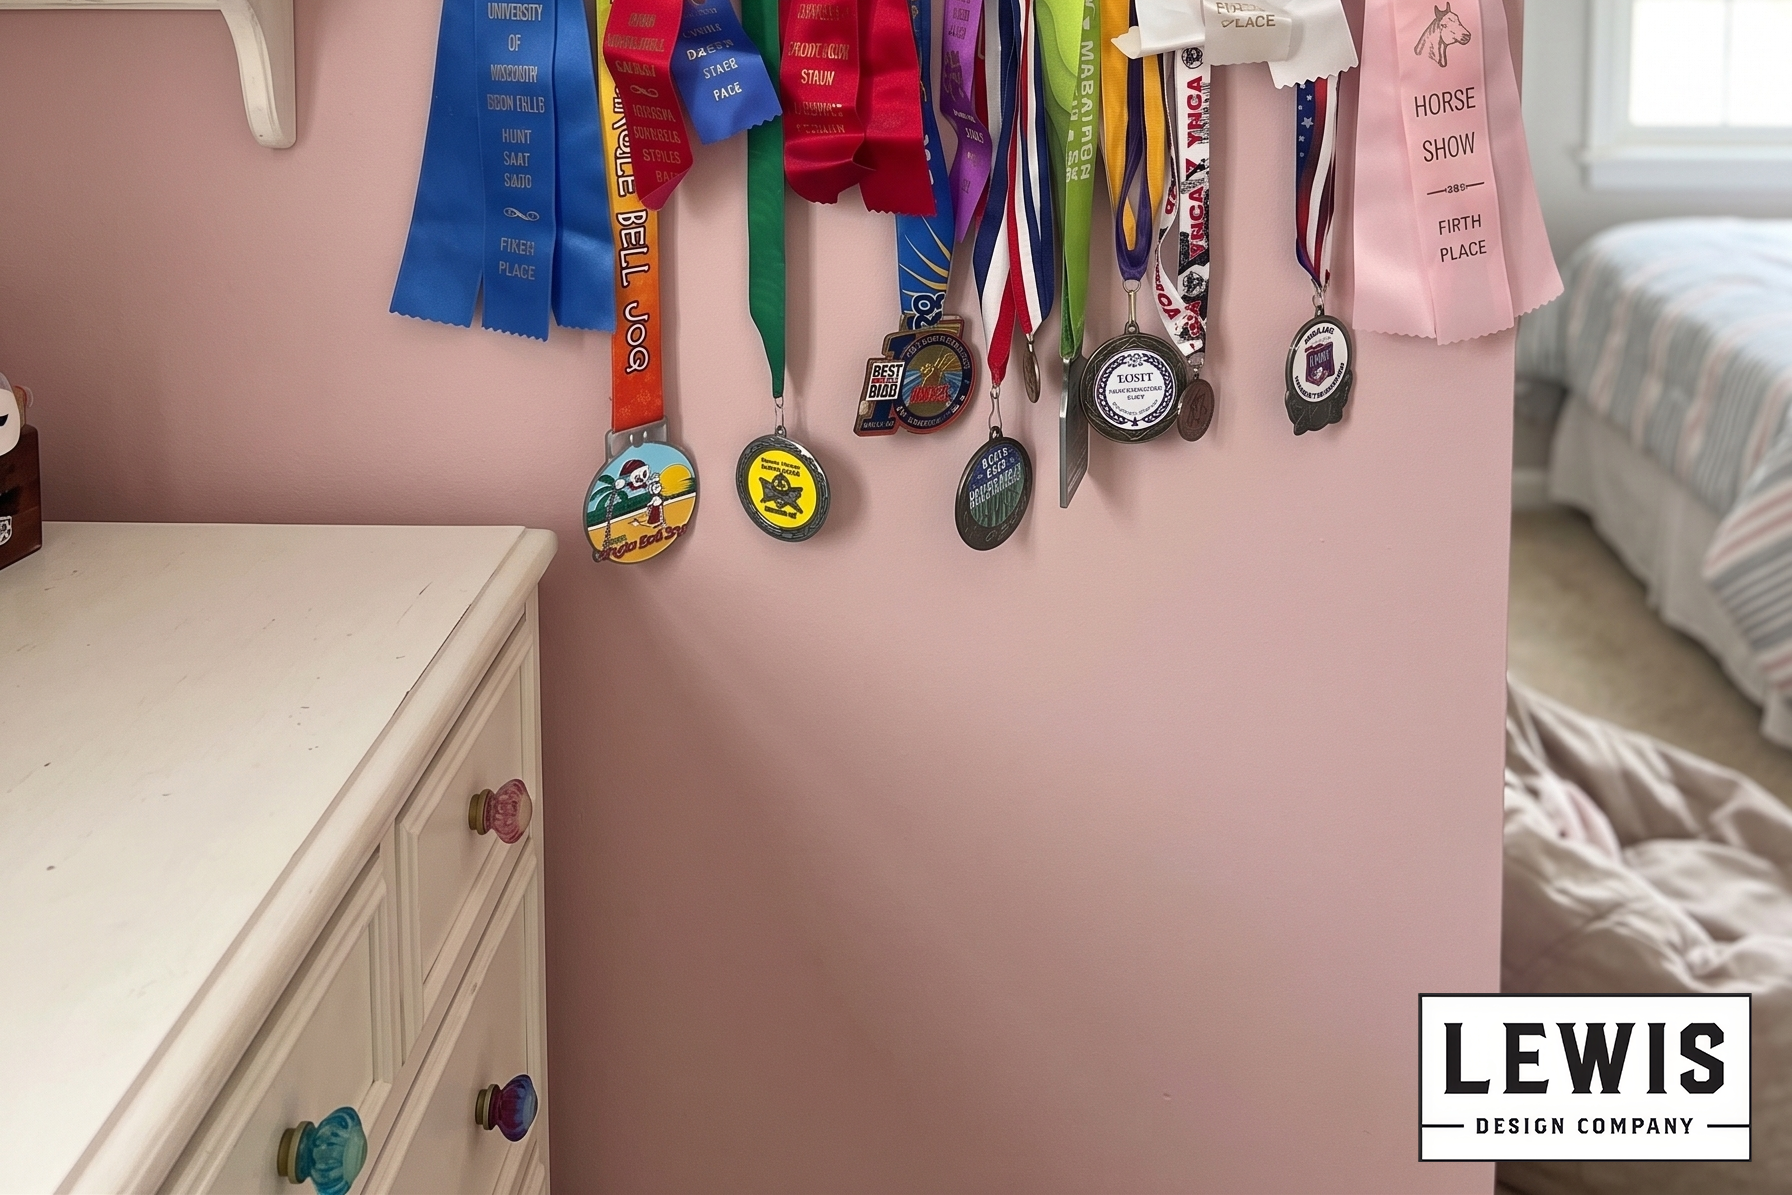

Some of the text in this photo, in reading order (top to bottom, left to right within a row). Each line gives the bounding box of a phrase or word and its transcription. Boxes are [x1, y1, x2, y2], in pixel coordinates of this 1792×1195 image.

[487, 2, 543, 21] UNIVERSITY
[508, 34, 521, 51] OF
[1414, 87, 1476, 118] HORSE
[502, 128, 532, 144] HUNT
[1422, 131, 1475, 162] SHOW
[1438, 214, 1482, 236] FIRTH
[1440, 239, 1487, 262] PLACE
[499, 261, 536, 280] PLACE
[873, 363, 903, 378] BEST
